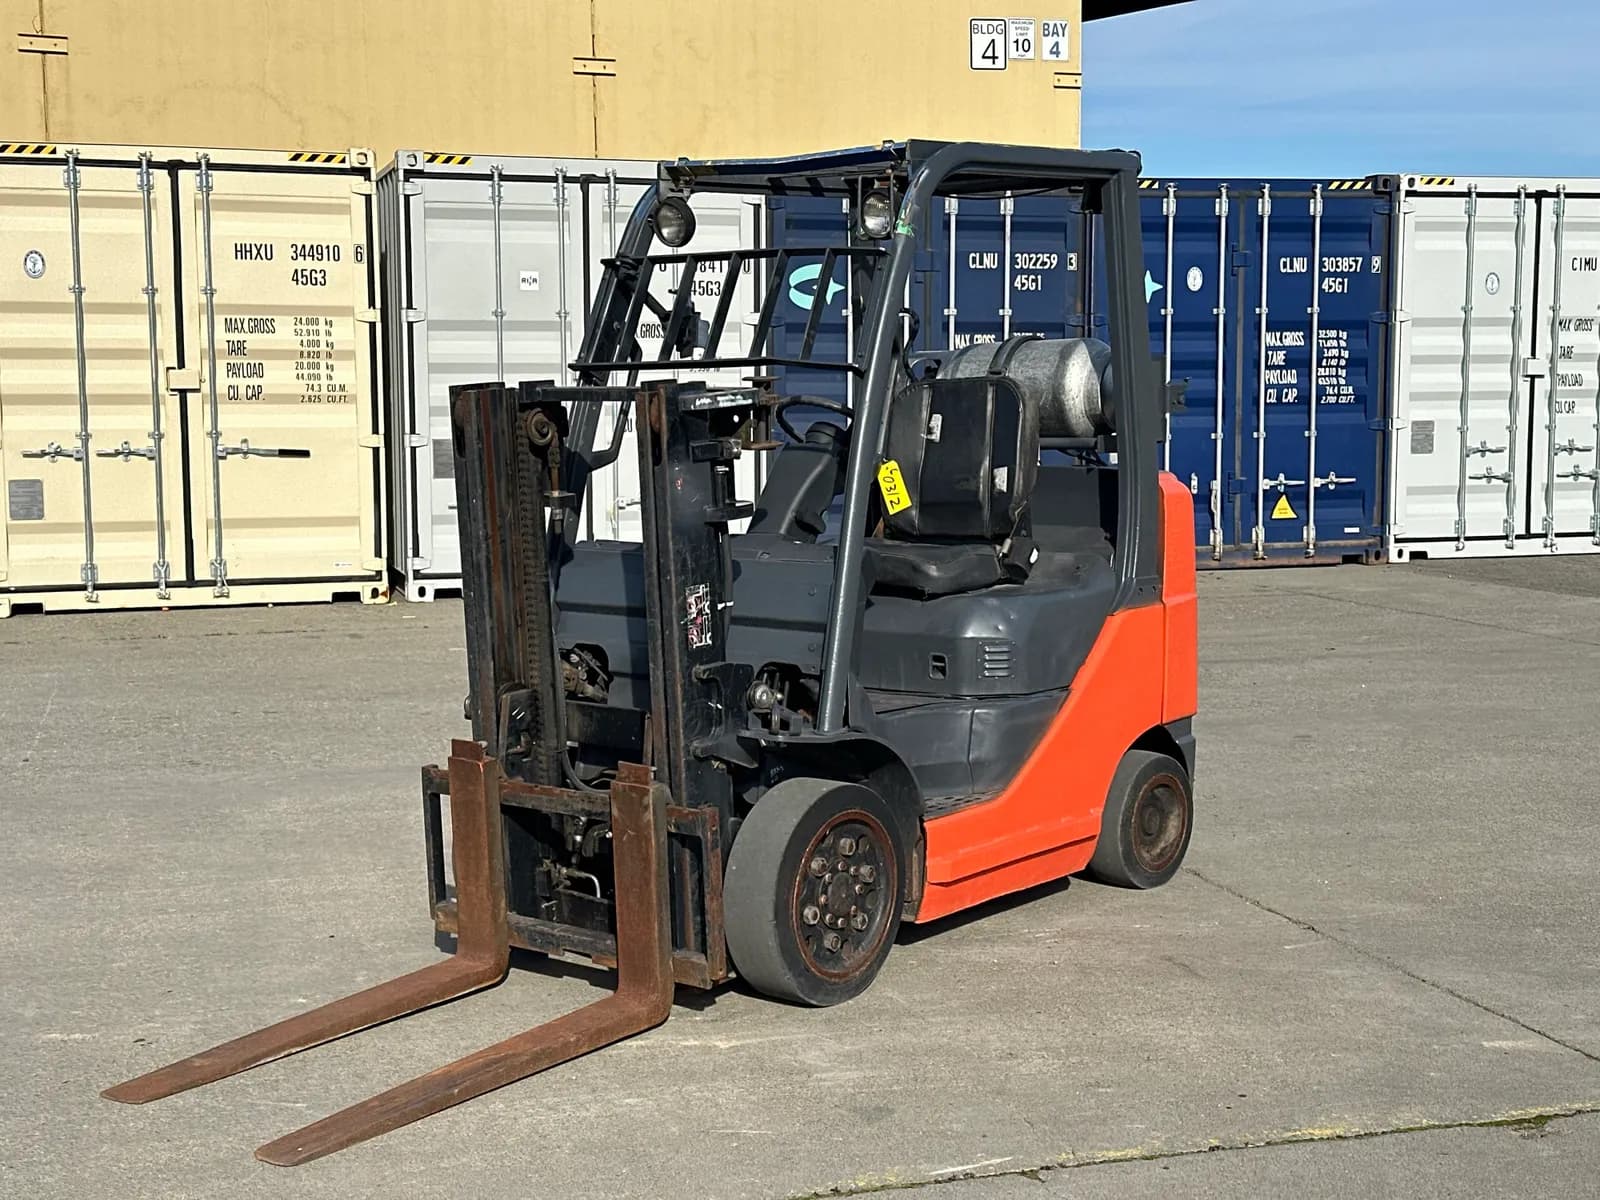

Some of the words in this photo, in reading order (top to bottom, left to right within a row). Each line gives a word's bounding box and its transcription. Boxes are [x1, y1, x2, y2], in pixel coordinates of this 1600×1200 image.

[972, 23, 1004, 35] BLDG
[1042, 22, 1067, 37] BAY
[981, 39, 999, 65] 4
[1012, 38, 1031, 53] 10
[1049, 41, 1061, 58] 4
[234, 243, 273, 260] HHXU
[290, 243, 341, 262] 344910
[354, 244, 363, 263] 6
[969, 253, 998, 269] CLNU
[1014, 253, 1058, 269] 302259
[1067, 253, 1078, 270] 3
[1280, 257, 1307, 273] CLNU
[1321, 257, 1363, 273] 303857
[1371, 256, 1381, 273] 9
[1571, 257, 1597, 271] CIMU
[291, 268, 327, 286] 45G3
[1013, 275, 1041, 291] 45G1
[691, 281, 721, 296] 45G3
[1321, 278, 1348, 293] 45G1
[324, 317, 333, 328] kg
[1574, 318, 1594, 331] GROSS
[226, 340, 247, 356] TARE
[326, 339, 334, 350] kg
[326, 351, 332, 359] lb
[1559, 345, 1574, 359] TARE
[1267, 350, 1287, 365] TARE
[226, 362, 264, 378] PAYLOAD
[326, 362, 334, 372] kg
[326, 373, 333, 381] lb
[1265, 369, 1297, 384] PAYLOAD
[1556, 373, 1583, 387] PAYLOAD
[246, 384, 266, 401] CAP.
[305, 384, 321, 392] 74.3
[1282, 389, 1298, 403] CAP.
